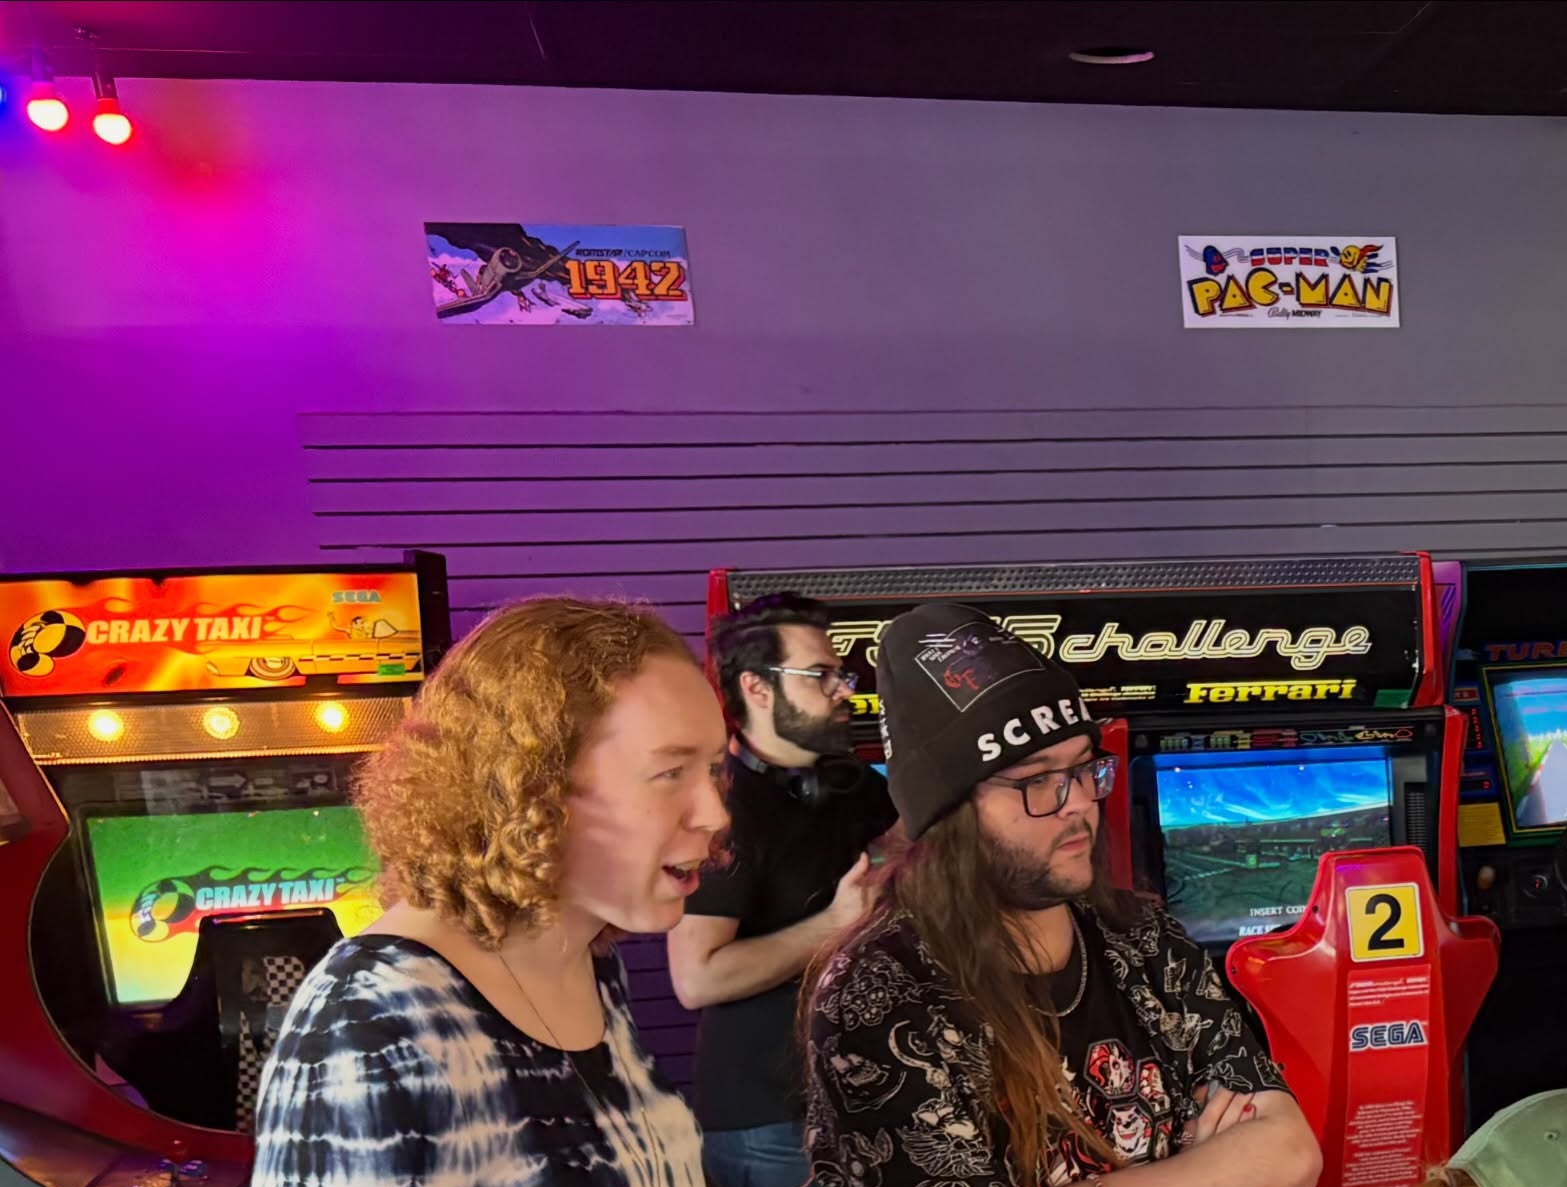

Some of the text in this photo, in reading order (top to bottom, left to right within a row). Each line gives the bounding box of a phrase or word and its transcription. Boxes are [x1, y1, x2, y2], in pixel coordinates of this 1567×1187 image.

[1249, 246, 1330, 267] SUPER
[565, 259, 688, 301] 1942
[1186, 266, 1394, 318] PAC-MAN
[332, 590, 382, 604] SEGA
[87, 615, 263, 645] CRAZY TAXI
[1184, 679, 1357, 704] Ferrari
[195, 877, 337, 910] CRAZY TAXI
[1249, 906, 1283, 917] INSERT
[1364, 893, 1405, 951] 2
[1238, 925, 1264, 937] RACE
[1350, 1019, 1429, 1052] SEGA
